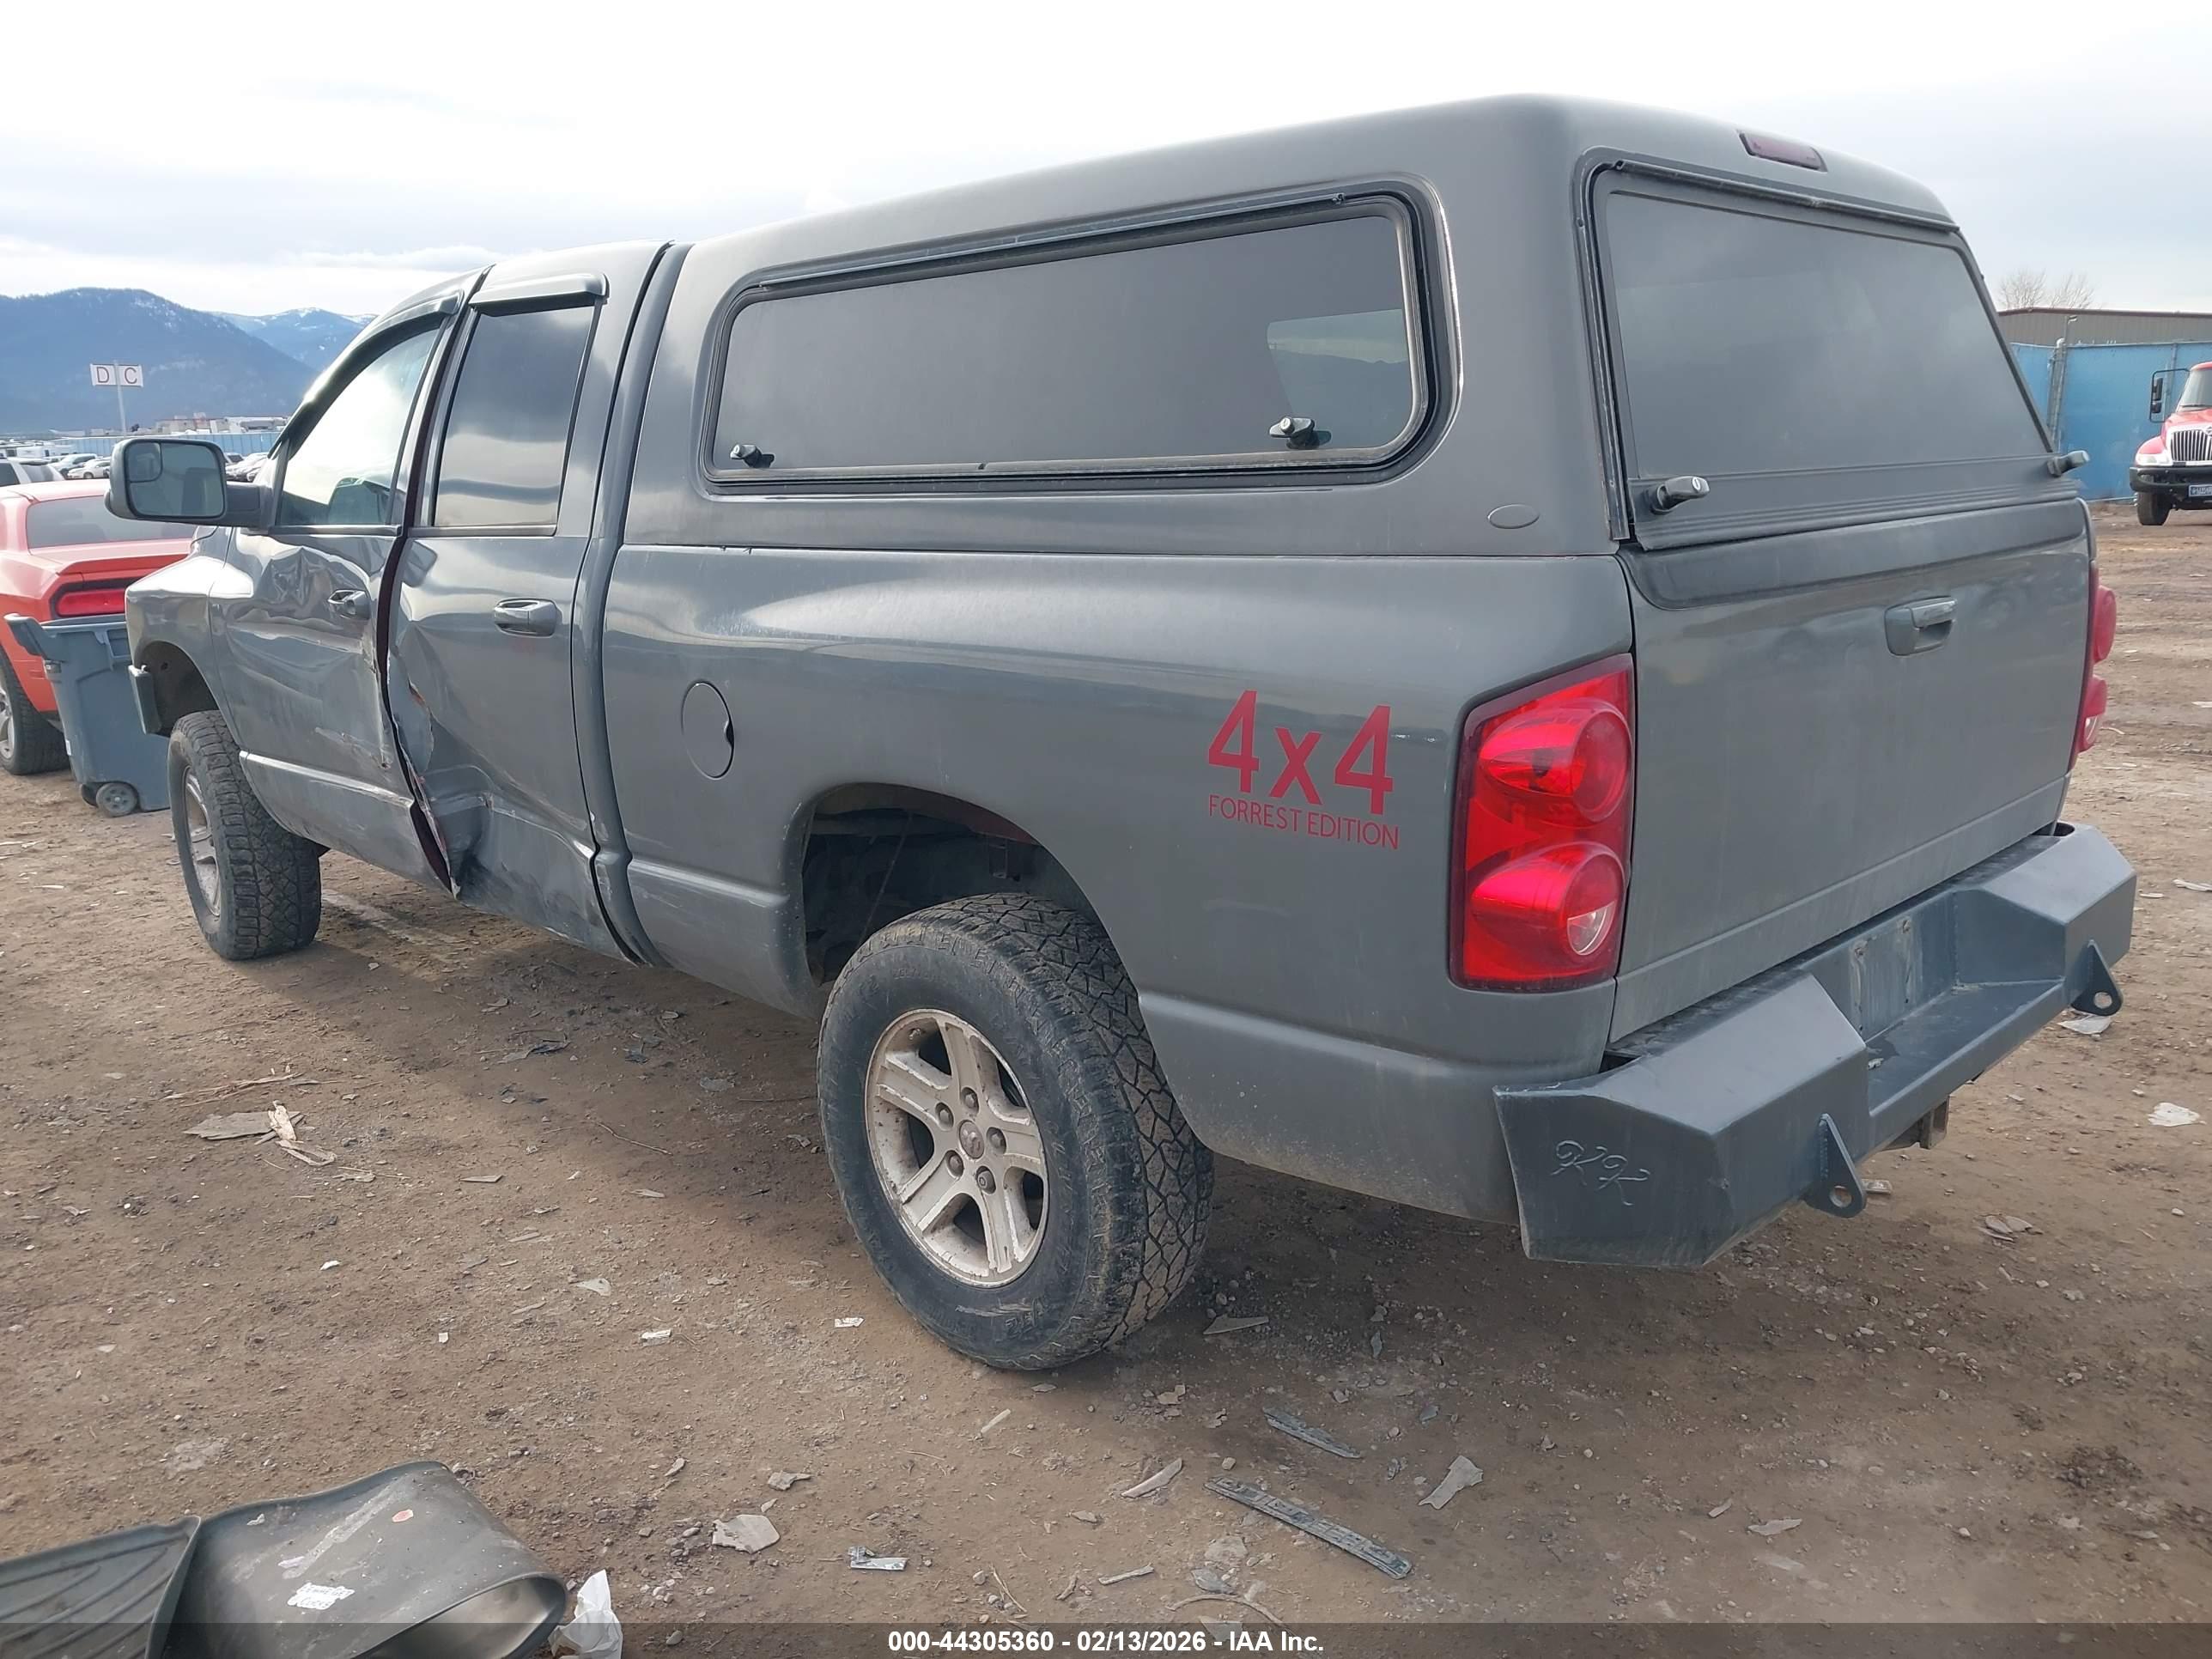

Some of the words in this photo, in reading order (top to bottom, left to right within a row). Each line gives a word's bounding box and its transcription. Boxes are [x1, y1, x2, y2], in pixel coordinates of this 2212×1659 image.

[96, 366, 110, 383] D
[124, 367, 137, 384] C
[1208, 690, 1394, 815] 4x4
[1208, 794, 1303, 832] FORREST
[1307, 811, 1399, 850] EDITION
